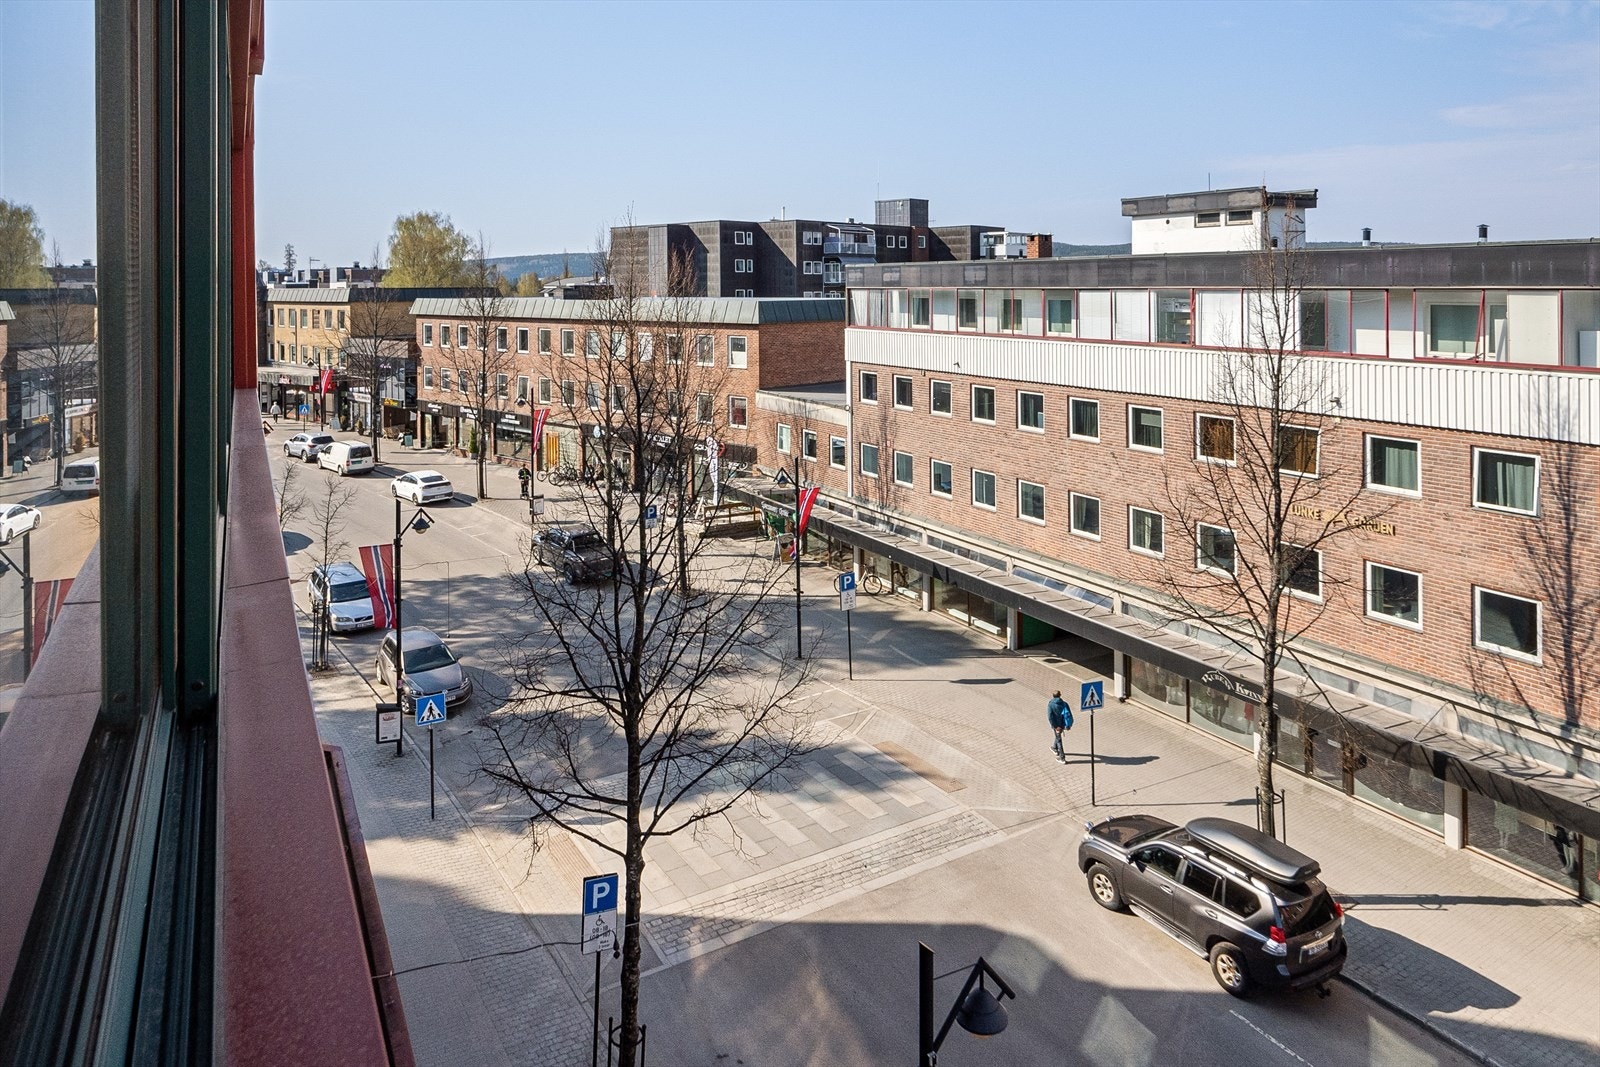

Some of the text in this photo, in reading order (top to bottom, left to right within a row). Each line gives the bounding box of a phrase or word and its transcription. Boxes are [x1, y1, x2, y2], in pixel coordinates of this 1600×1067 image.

[647, 507, 655, 518] P
[843, 576, 852, 589] P
[592, 882, 610, 909] P
